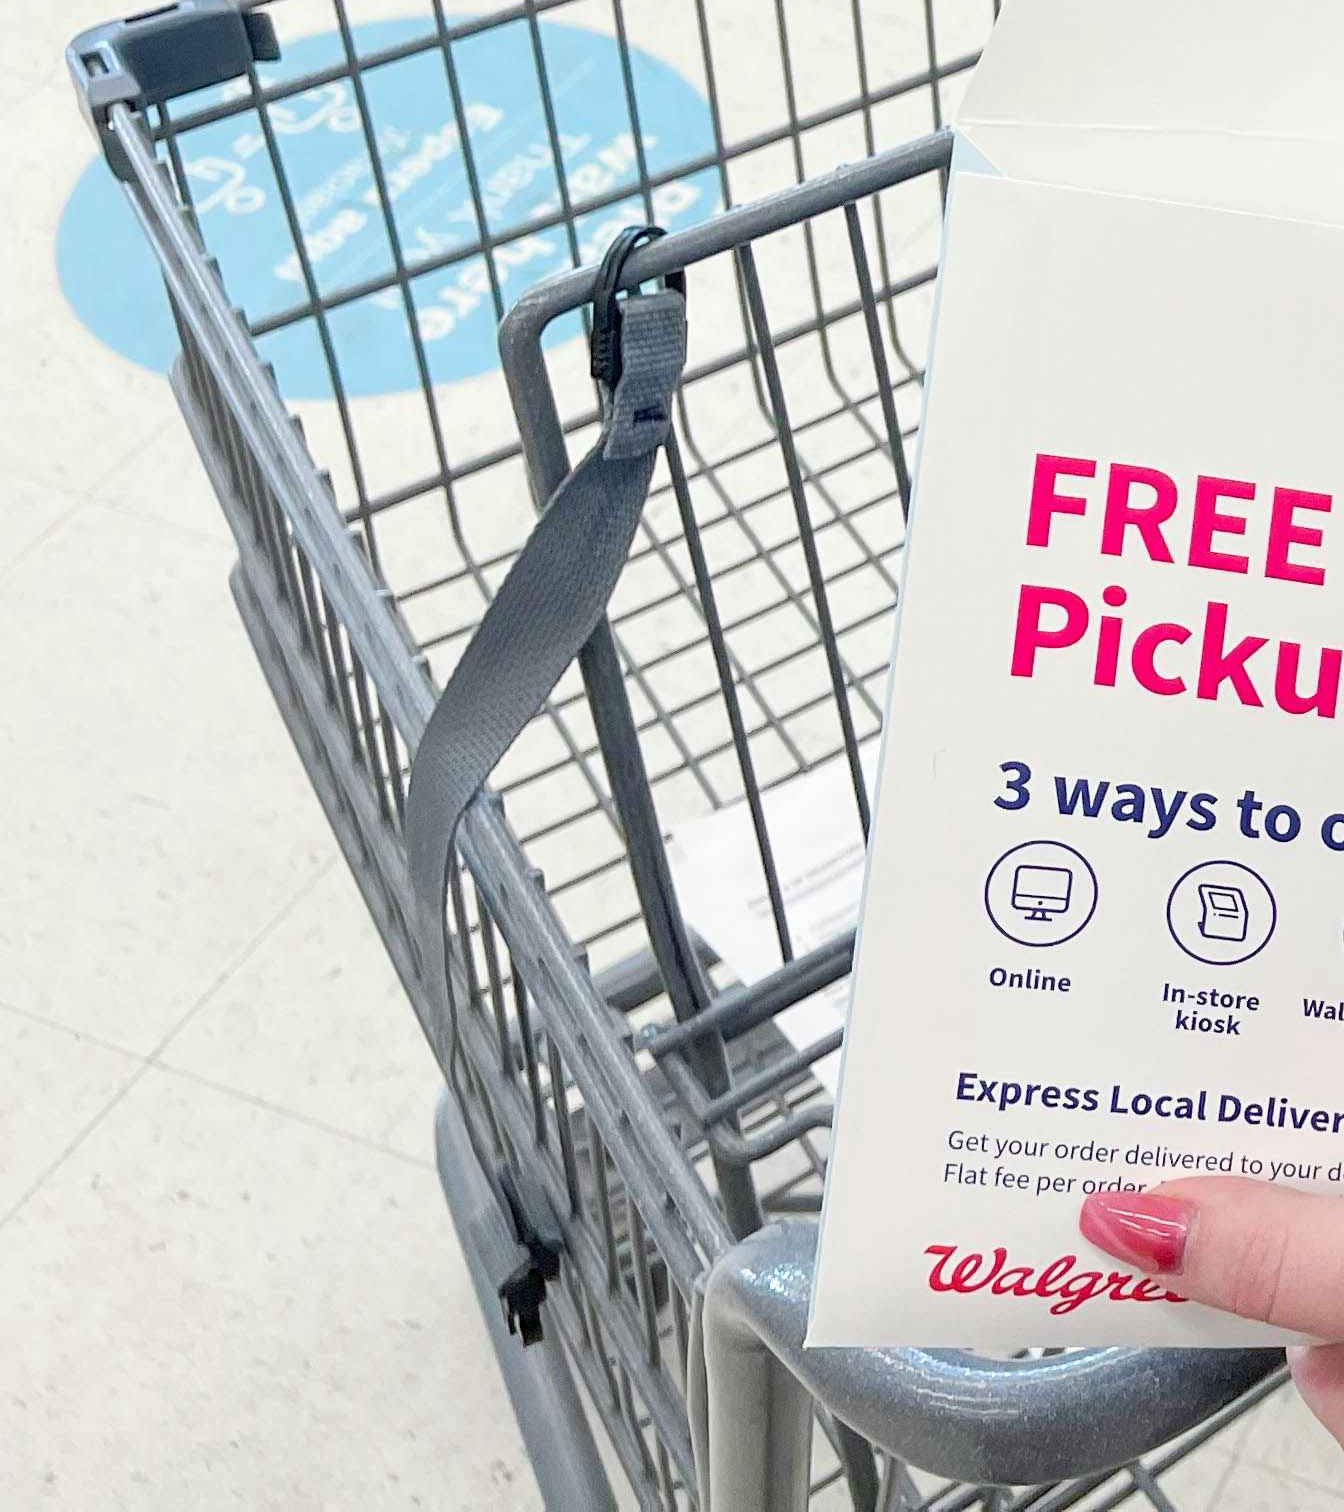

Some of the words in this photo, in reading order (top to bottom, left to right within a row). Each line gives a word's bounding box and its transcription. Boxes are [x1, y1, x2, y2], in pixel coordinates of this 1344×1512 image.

[1026, 453, 1333, 586] FREE
[993, 760, 1032, 811] 3
[1054, 775, 1218, 838] ways
[1237, 790, 1302, 843] to
[988, 967, 1072, 993] Online
[1162, 983, 1261, 1012] In-store
[1174, 1010, 1241, 1036] kiosk
[956, 1072, 1100, 1112] Express
[1109, 1086, 1207, 1122] Local
[948, 1130, 989, 1153] Get
[993, 1134, 1050, 1160] your
[1054, 1140, 1119, 1164] order
[1124, 1143, 1234, 1173] delivered
[1240, 1152, 1264, 1175] to
[1269, 1160, 1322, 1181] your
[943, 1163, 988, 1186] Flat
[993, 1166, 1030, 1189] fee
[1035, 1174, 1078, 1196] per
